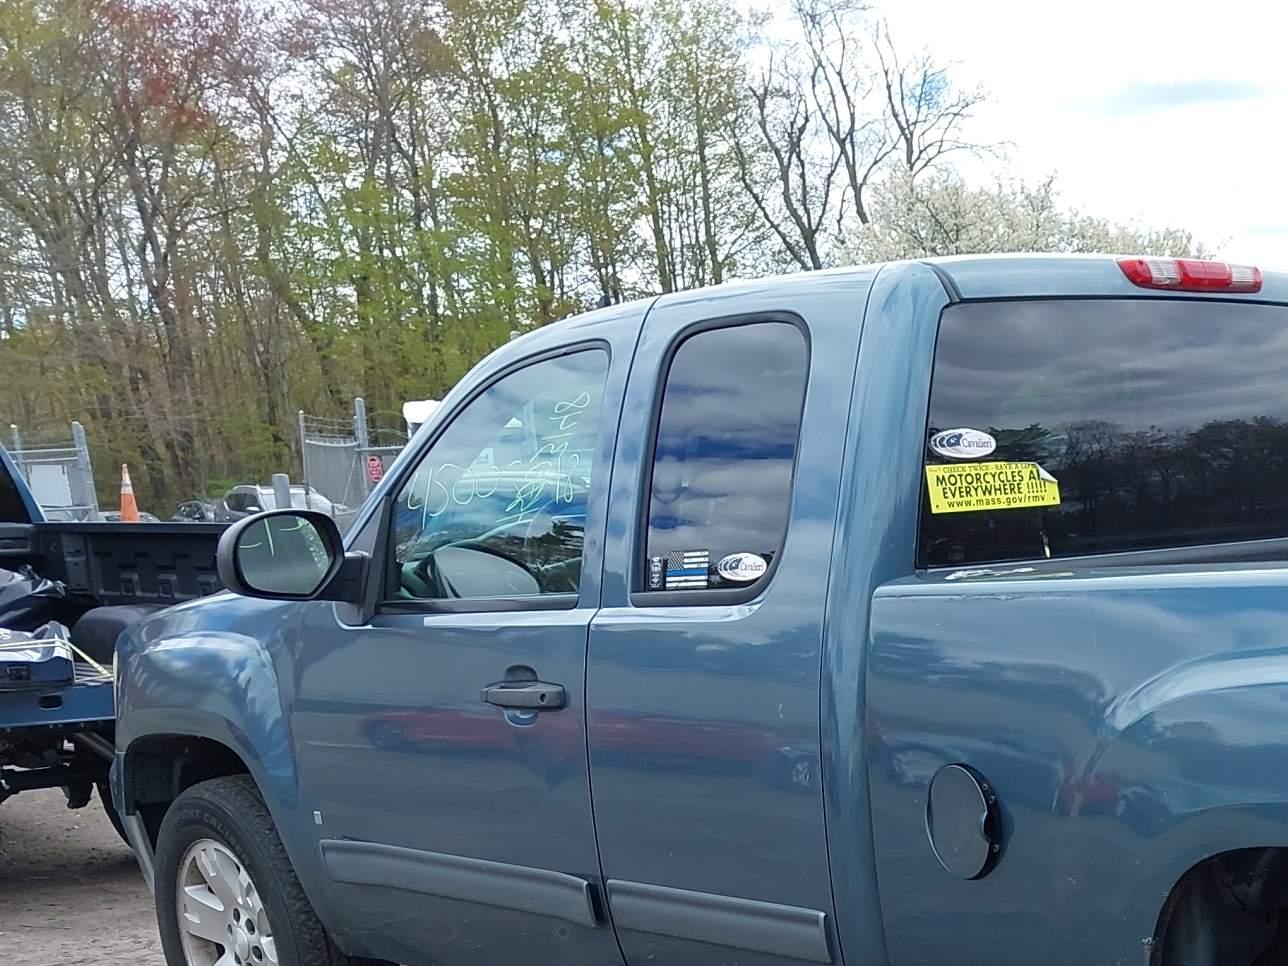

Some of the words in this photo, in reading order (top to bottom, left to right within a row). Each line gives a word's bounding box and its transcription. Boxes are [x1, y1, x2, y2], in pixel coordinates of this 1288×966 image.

[942, 466, 964, 474] CHECK
[966, 465, 990, 473] TWICE
[994, 463, 1014, 472] SAVE
[936, 470, 1024, 488] MOTORCYCLES
[942, 482, 1023, 500] EVERYWHERE
[947, 494, 1046, 508] www.mass.gov/rmv
